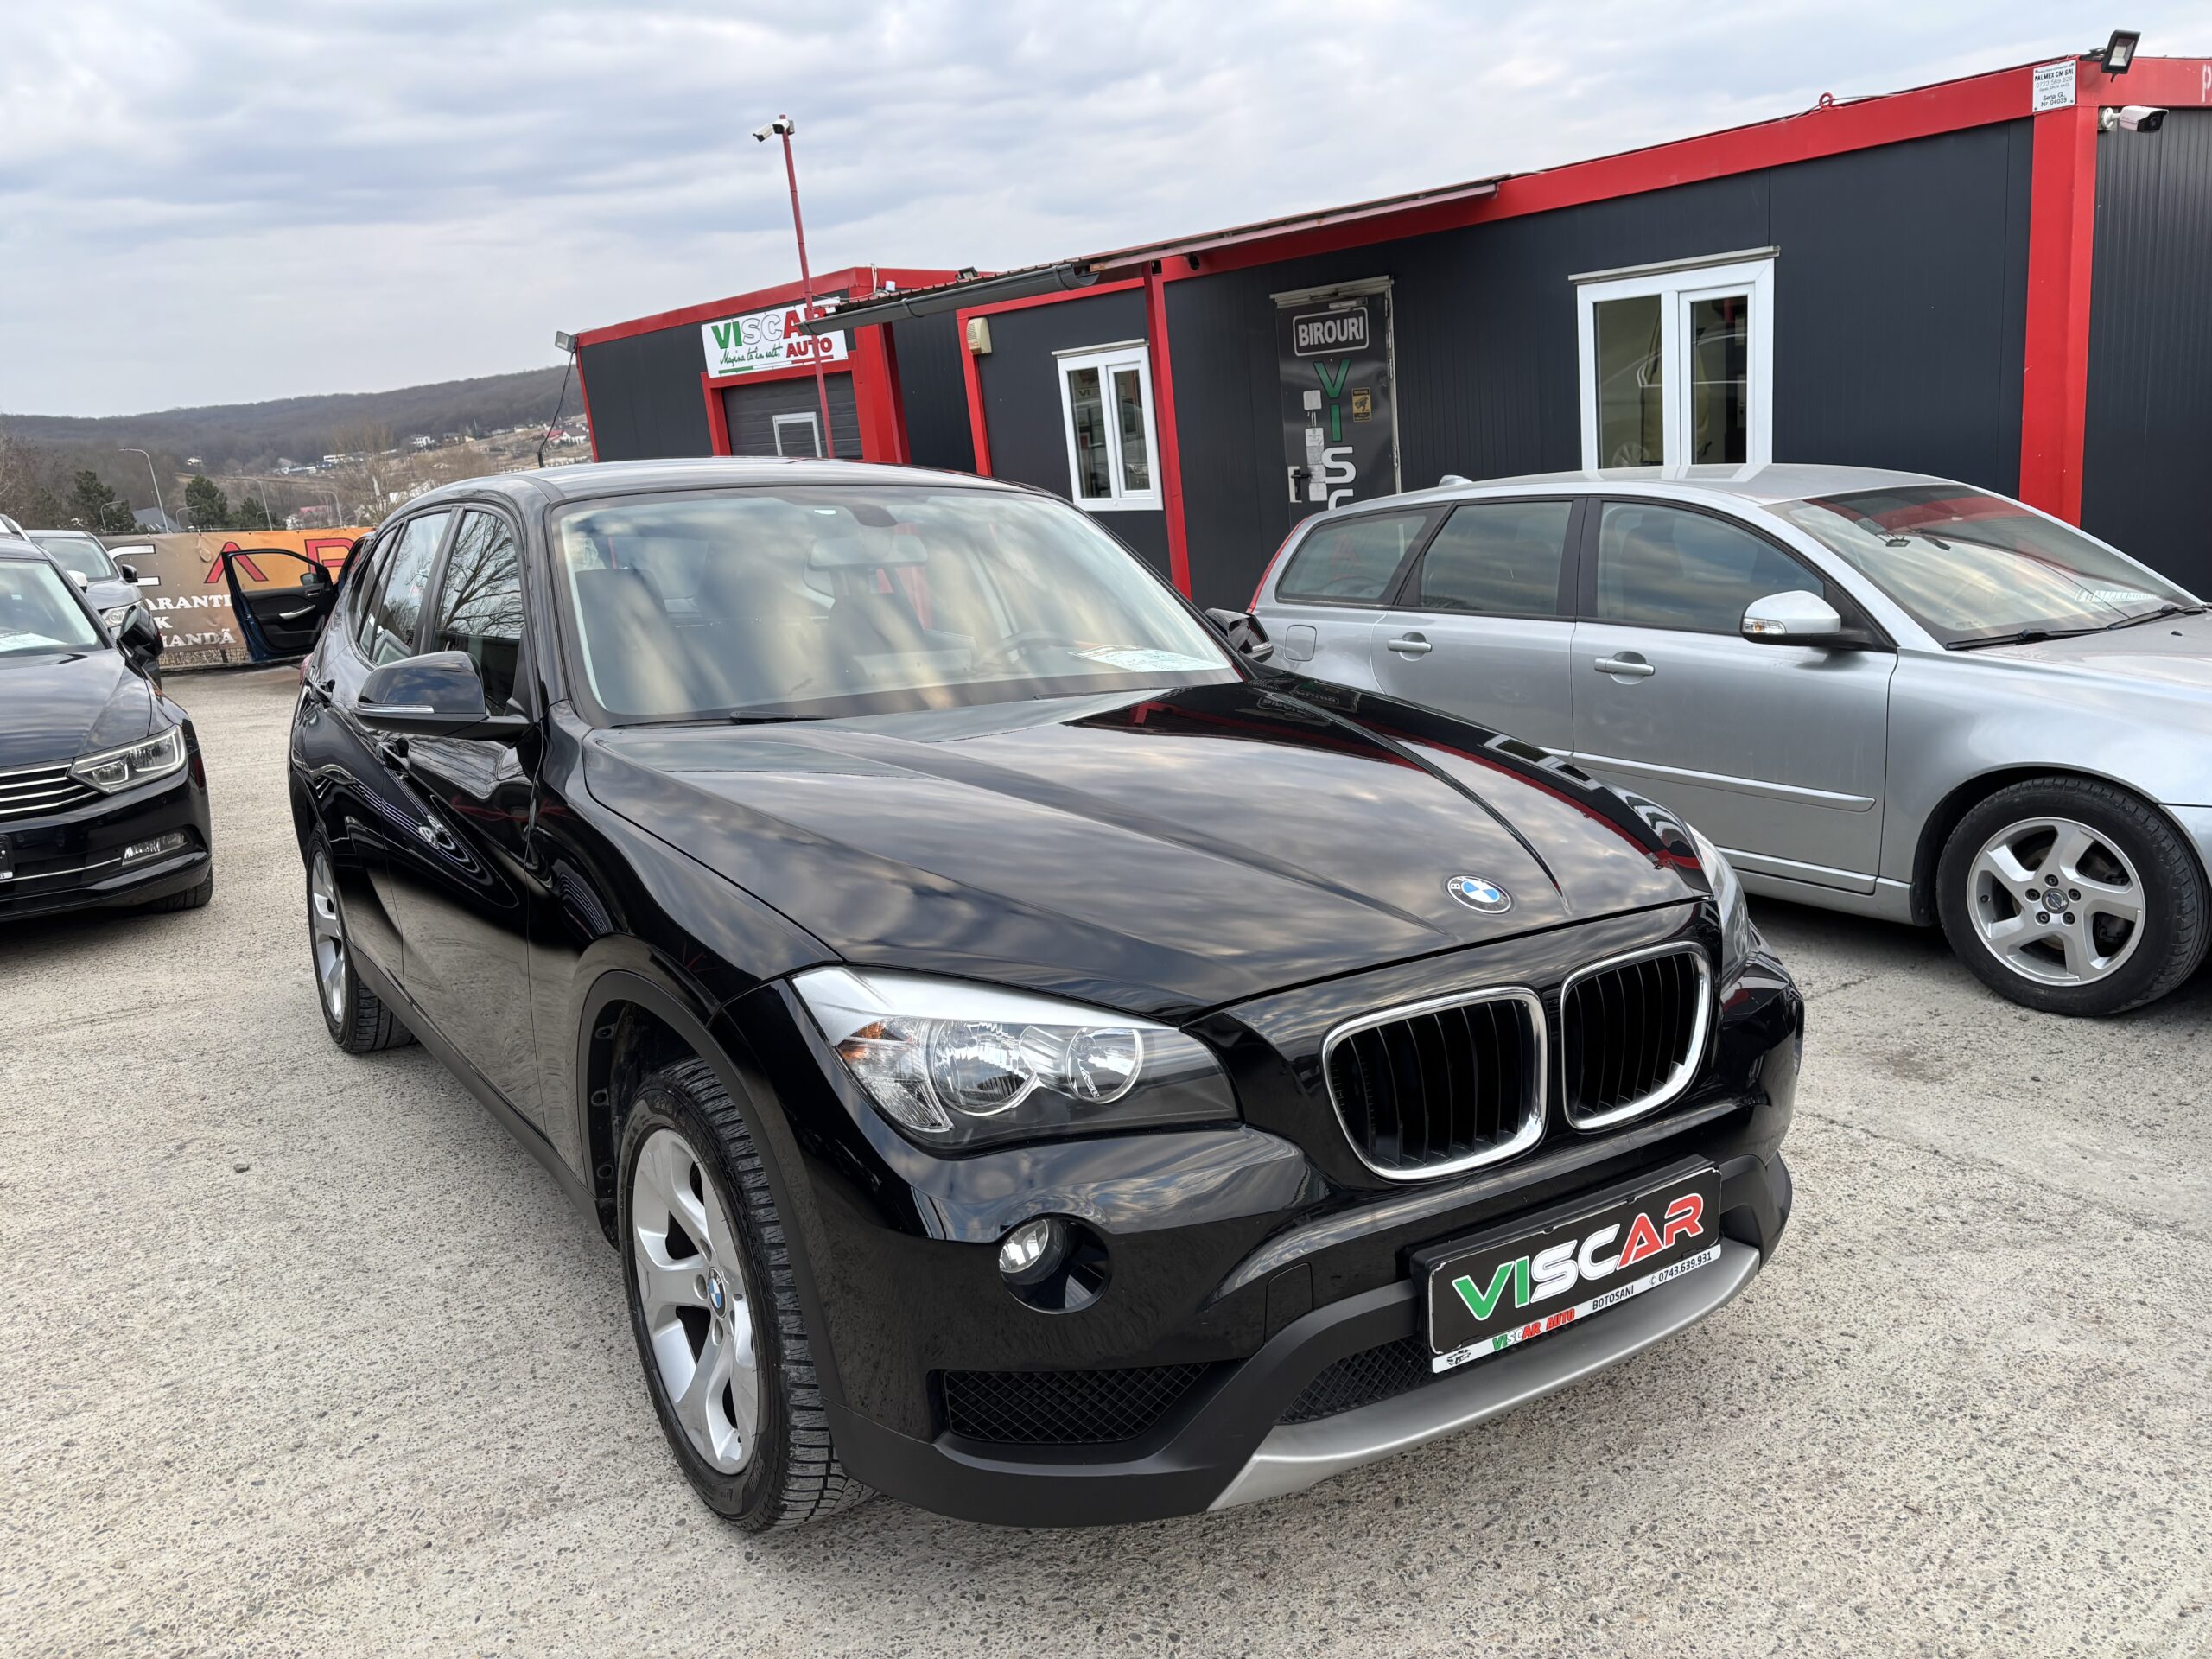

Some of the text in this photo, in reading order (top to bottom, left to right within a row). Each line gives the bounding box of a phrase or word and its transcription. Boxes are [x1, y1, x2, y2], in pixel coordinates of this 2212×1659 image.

[2035, 73, 2054, 81] PALMEX
[1298, 316, 1364, 347] BIROURI
[1452, 1193, 1704, 1320] VISCAR
[1492, 1252, 1712, 1351] VISCAR AUTO BOTOSANI 0743.639.931
